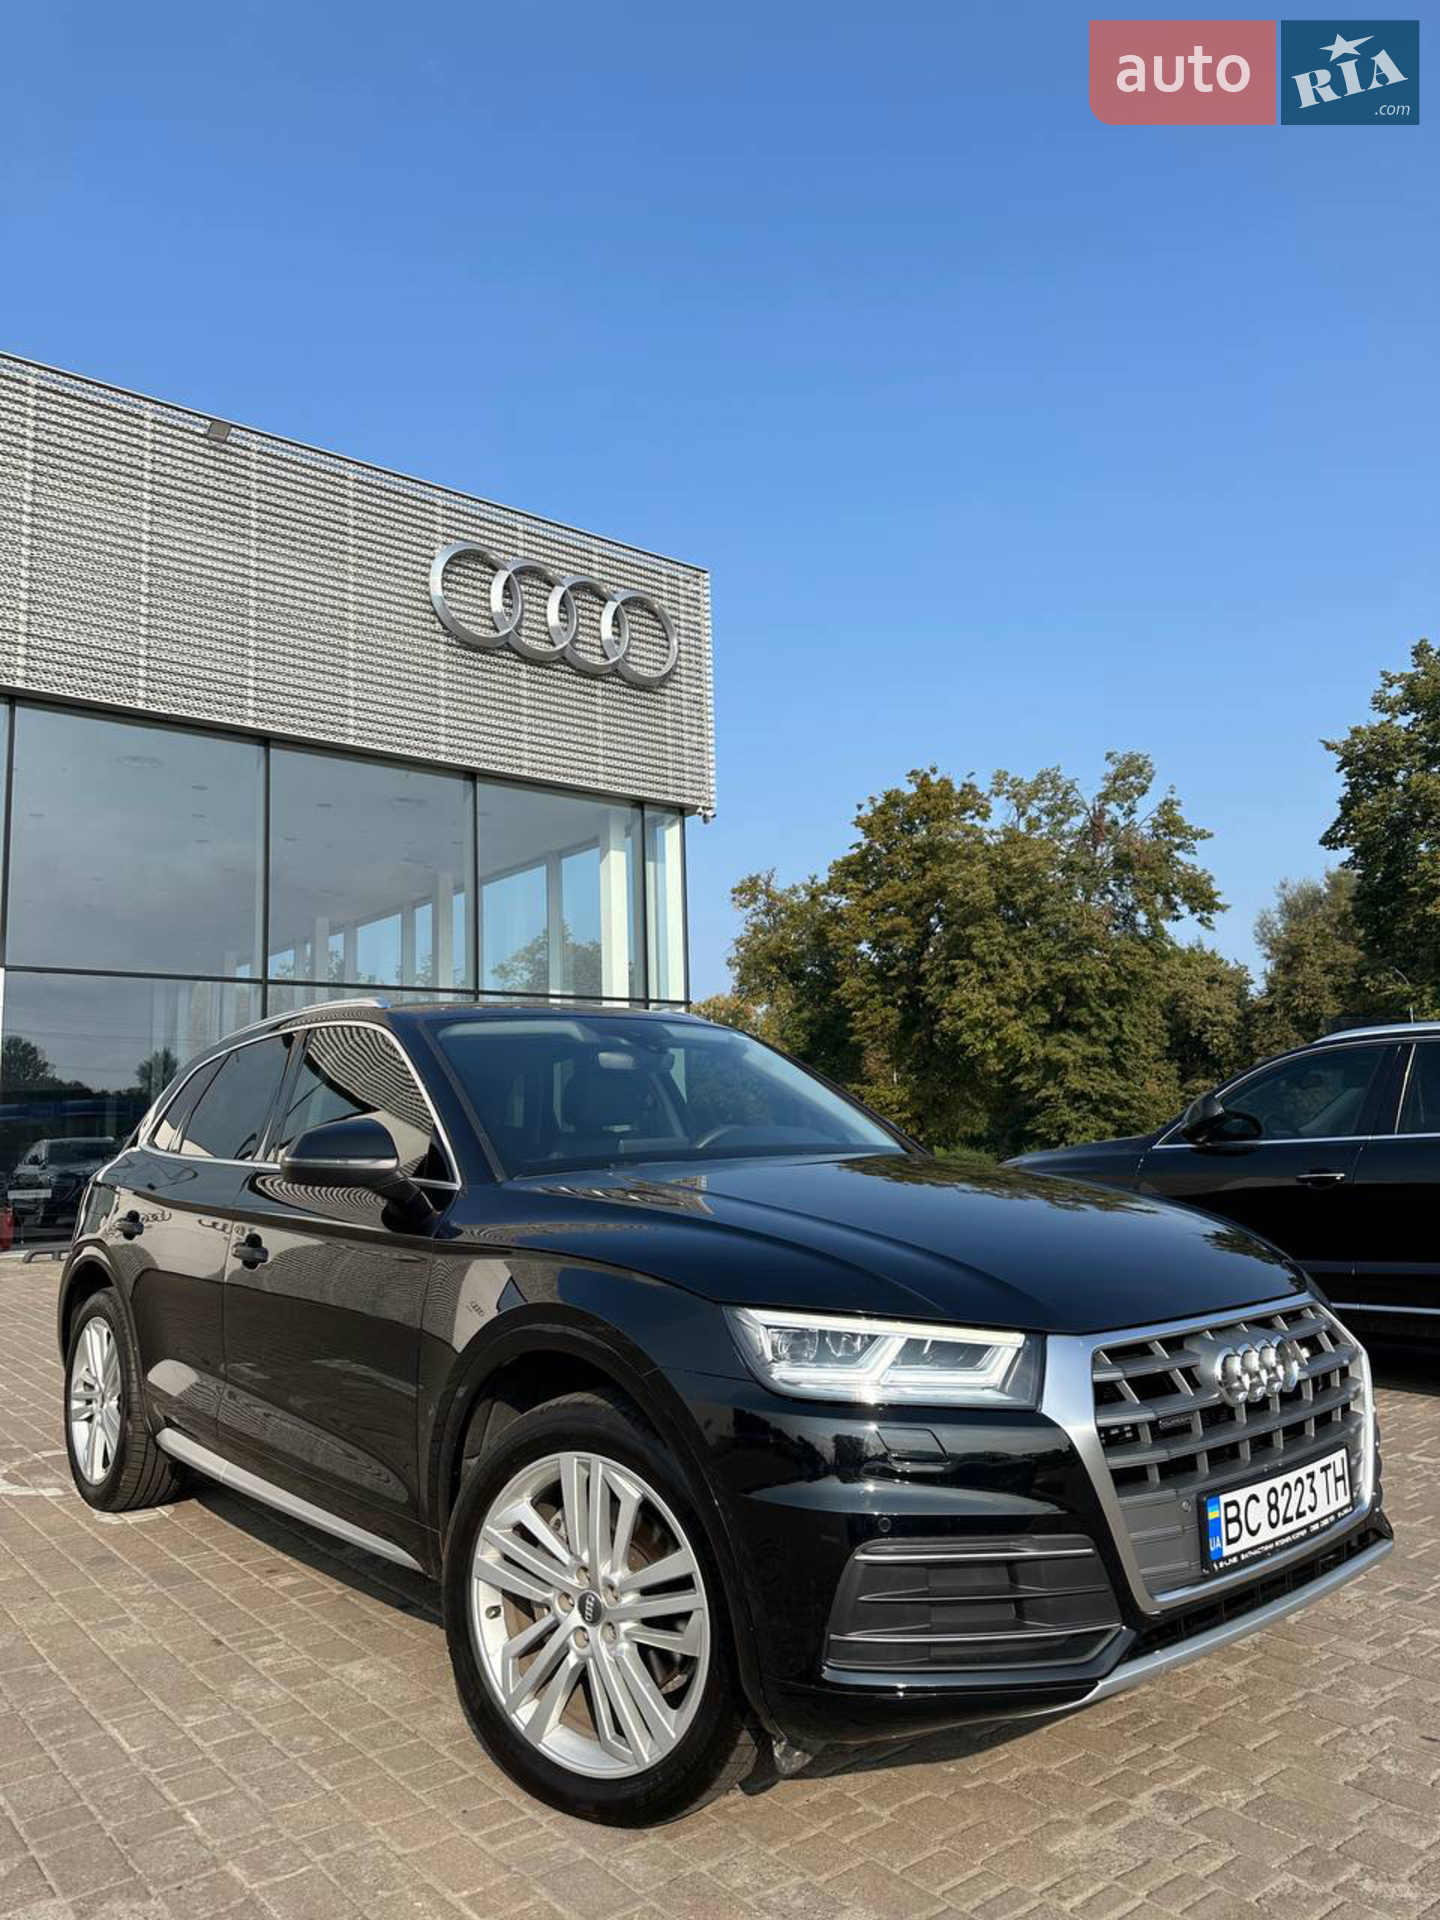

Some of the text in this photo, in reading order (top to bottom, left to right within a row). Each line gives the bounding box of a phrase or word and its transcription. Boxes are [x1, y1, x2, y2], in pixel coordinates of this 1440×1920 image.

[1223, 1456, 1348, 1546] BC 8223 TH
[1209, 1536, 1222, 1552] UA
